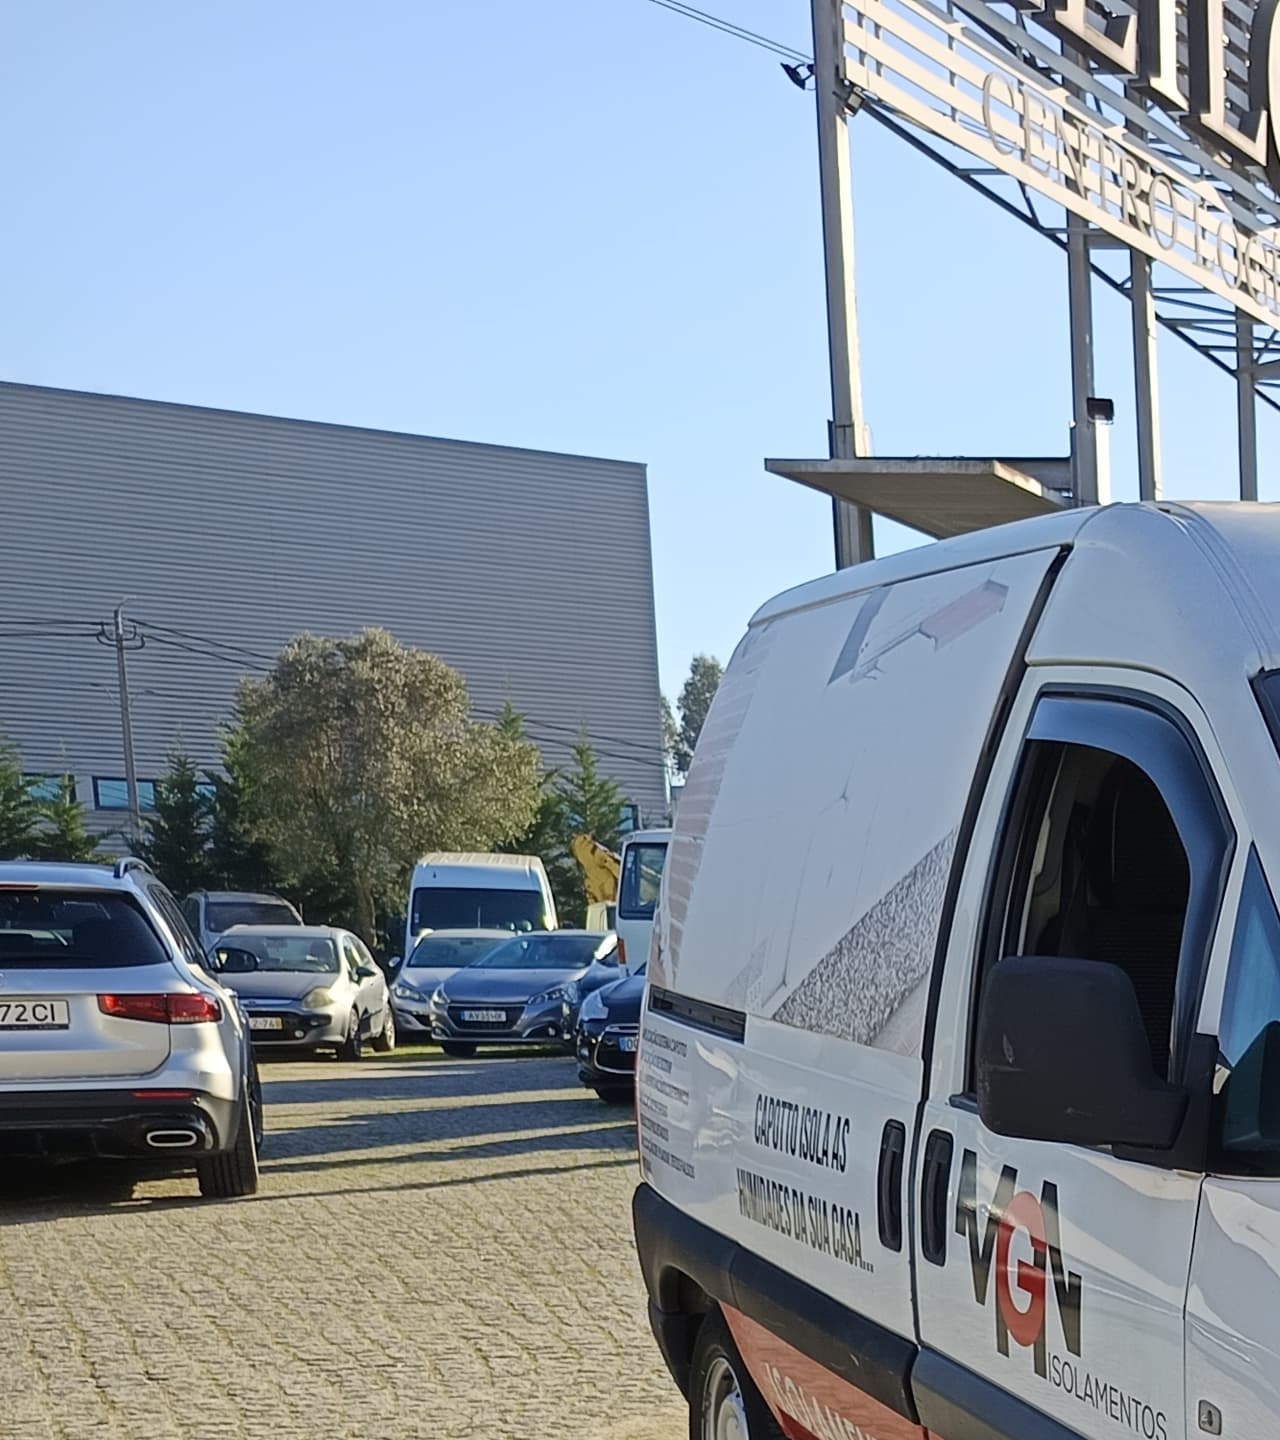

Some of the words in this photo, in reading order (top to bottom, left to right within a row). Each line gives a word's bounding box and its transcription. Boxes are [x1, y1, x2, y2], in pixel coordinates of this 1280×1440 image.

[982, 71, 1178, 250] CENTRO
[754, 1093, 800, 1156] CAPOTTO
[799, 1105, 831, 1168] ISOLA
[831, 1116, 850, 1173] AS
[736, 1167, 792, 1238] HUMIDADES
[791, 1188, 808, 1245] DA
[808, 1195, 832, 1256] SUA
